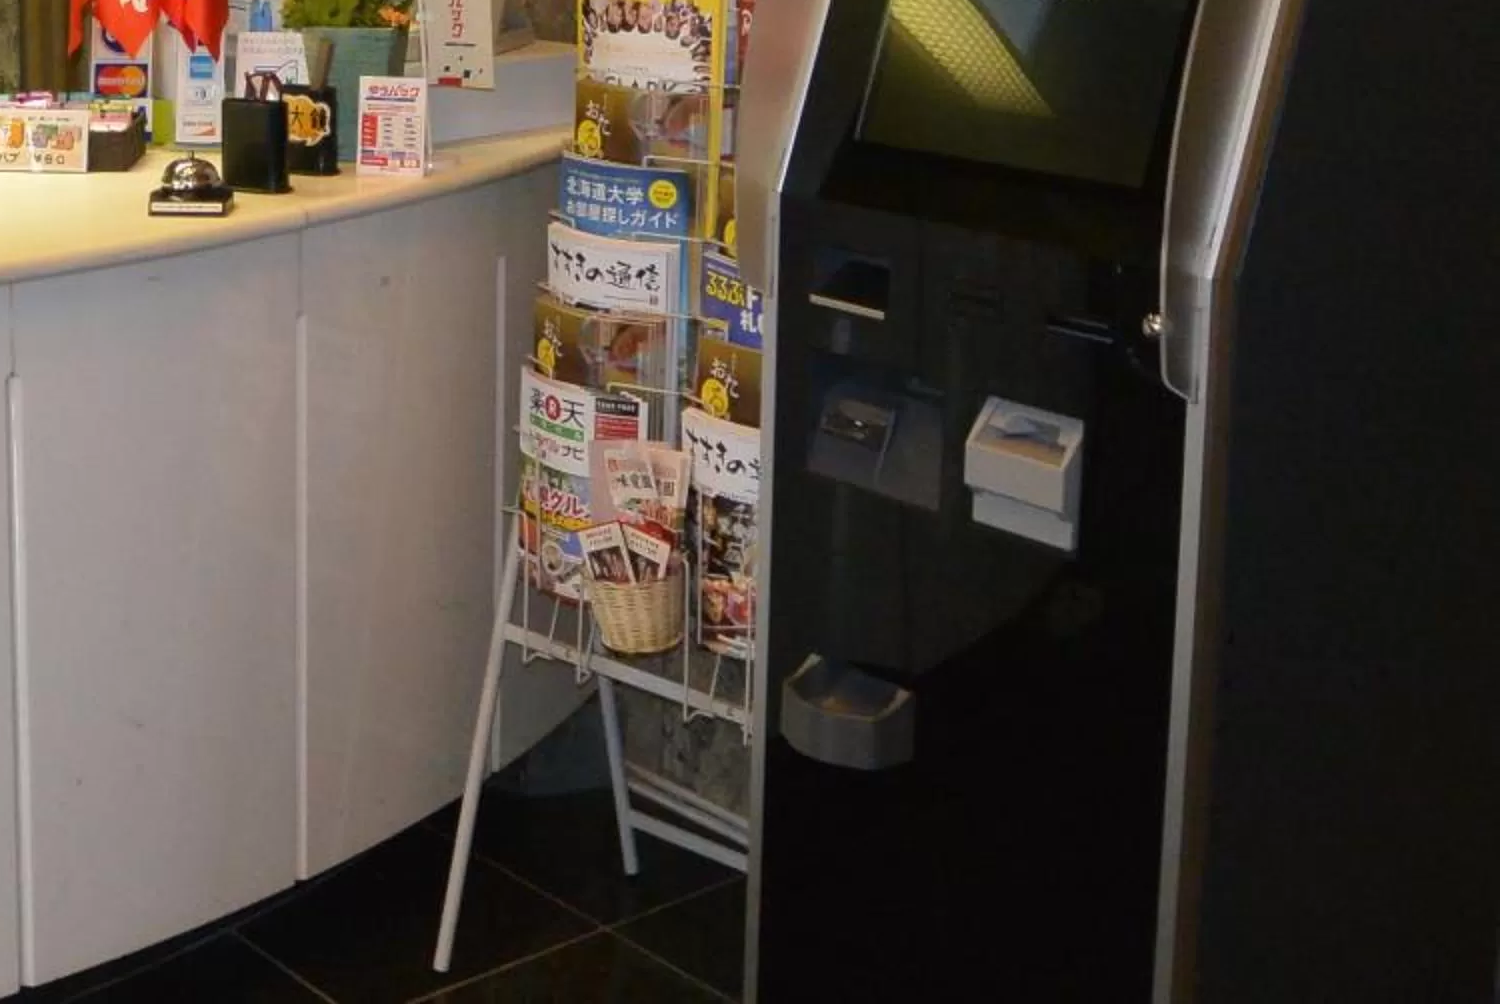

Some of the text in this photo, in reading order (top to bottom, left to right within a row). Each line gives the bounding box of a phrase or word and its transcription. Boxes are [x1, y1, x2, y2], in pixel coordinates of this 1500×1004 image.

[565, 175, 645, 205] 北海道大学
[739, 308, 763, 336] 札
